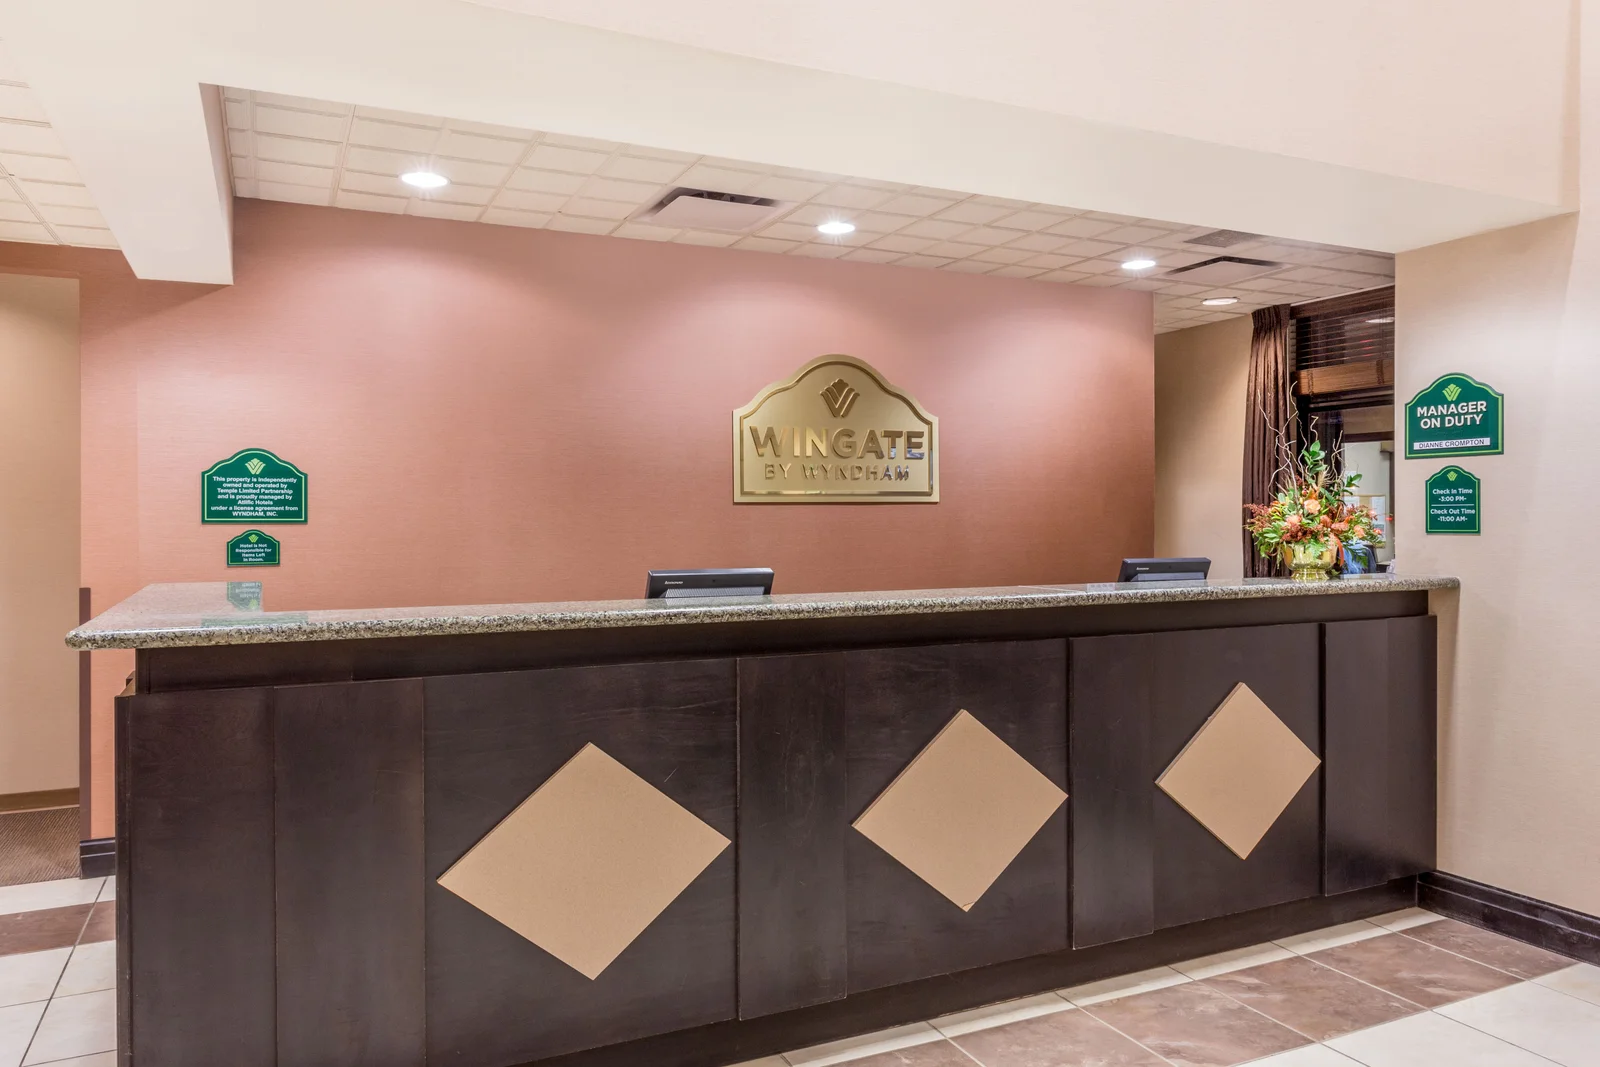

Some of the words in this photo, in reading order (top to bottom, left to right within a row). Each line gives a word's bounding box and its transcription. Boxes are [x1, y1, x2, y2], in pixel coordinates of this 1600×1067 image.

[1417, 401, 1487, 417] MANAGER
[1420, 418, 1440, 429] ON
[1445, 414, 1483, 427] DUTY
[749, 426, 925, 460] WINGATE
[764, 463, 792, 480] BY
[802, 463, 910, 481] WYNDHAM
